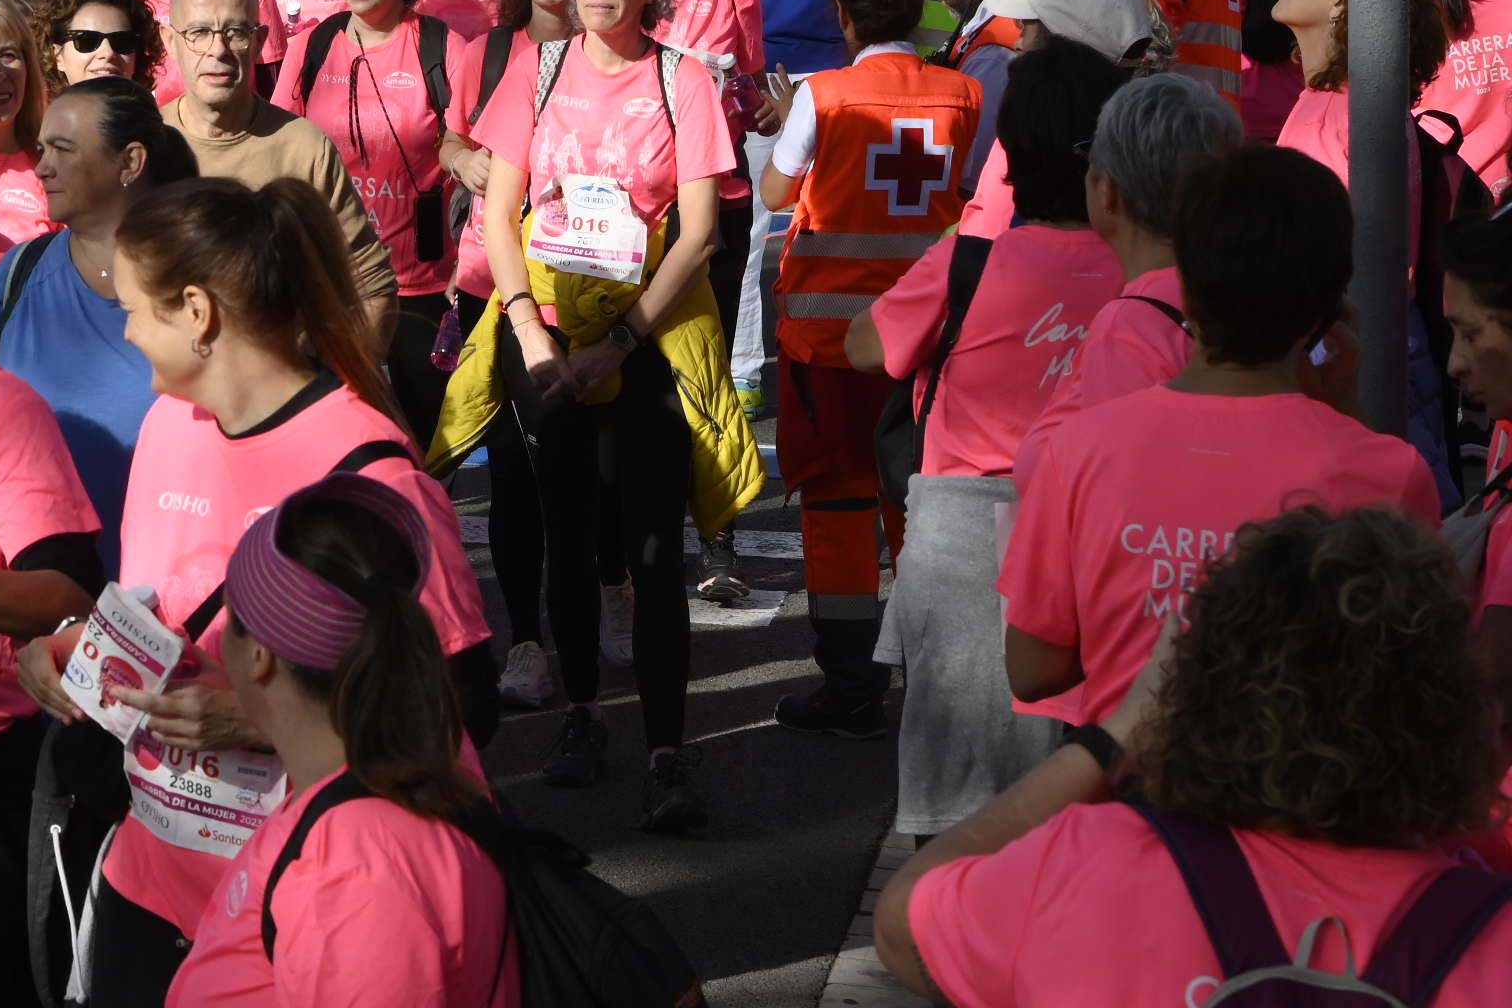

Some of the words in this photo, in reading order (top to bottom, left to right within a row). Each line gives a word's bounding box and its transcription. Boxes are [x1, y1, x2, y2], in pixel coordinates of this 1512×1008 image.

[1453, 56, 1477, 74] DE
[1483, 52, 1505, 69] LA
[1454, 67, 1510, 90] MUJER
[571, 215, 610, 234] 016
[168, 745, 220, 779] 016
[169, 774, 212, 800] 23888
[172, 796, 187, 809] DE
[187, 799, 201, 812] LA
[202, 803, 238, 822] MUJER
